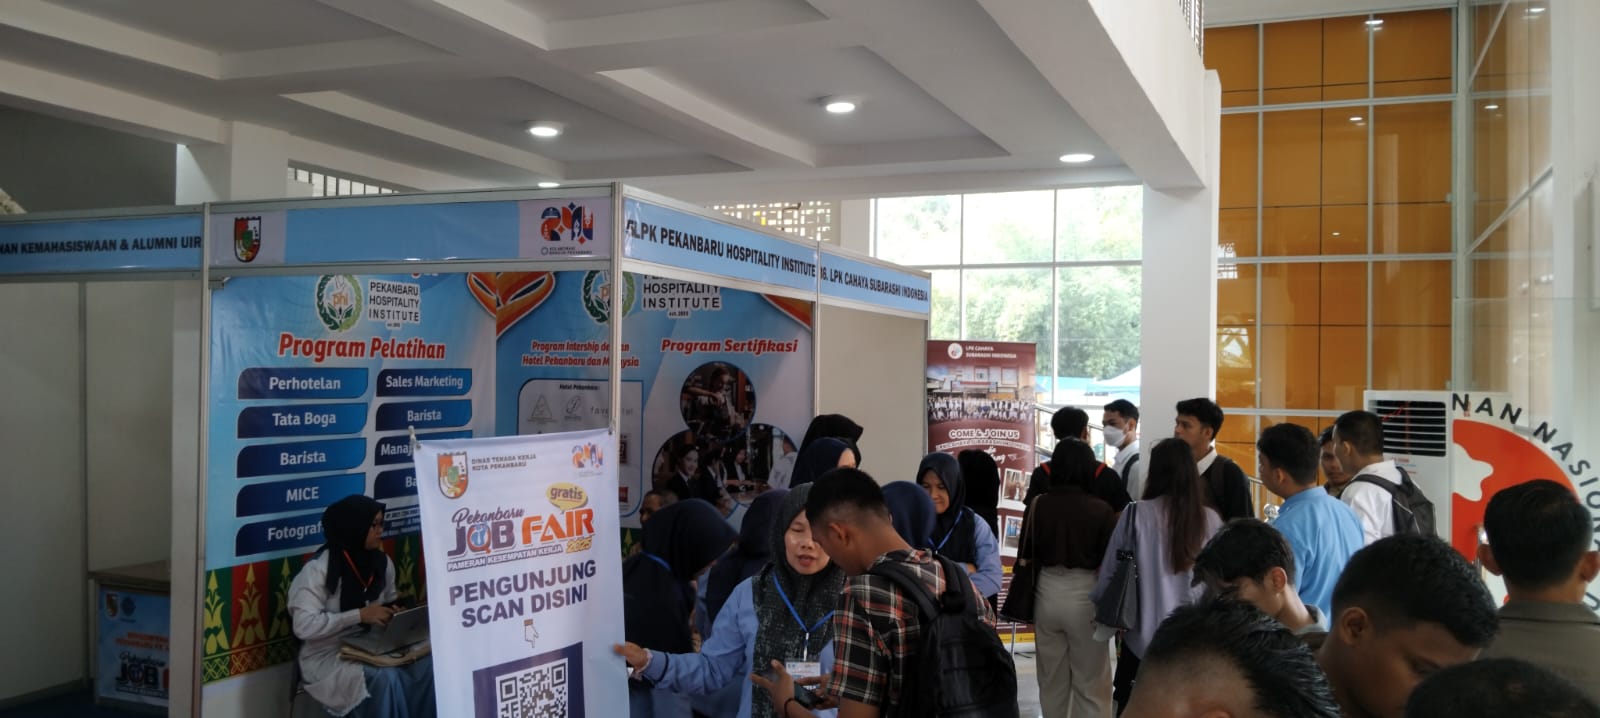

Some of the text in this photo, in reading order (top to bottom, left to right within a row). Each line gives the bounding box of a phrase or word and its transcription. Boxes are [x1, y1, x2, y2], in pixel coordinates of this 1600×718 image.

[20, 237, 117, 254] KEMAHASISWAAN
[120, 238, 129, 251] &
[132, 237, 178, 251] ALUMNI
[181, 236, 202, 250] UIR
[660, 228, 724, 257] PEKANBARU
[726, 244, 780, 270] HOSPITALITY
[781, 256, 816, 278] INSTITUTE
[370, 281, 419, 296] PEKANBARU
[643, 282, 720, 294] HOSPITALITY
[830, 268, 843, 284] LPK
[844, 272, 869, 290] CAHAYA
[869, 278, 901, 297] SUBARASHI
[901, 285, 929, 302] INDONESIA
[369, 295, 419, 308] HOSPITALITY
[643, 297, 720, 309] INSTITUTE
[368, 309, 419, 322] INSTITUTE
[278, 333, 446, 363] Program Pelatihan
[532, 341, 630, 353] Program Intership dean
[660, 338, 799, 356] Program Sertifikasi
[522, 355, 640, 369] Hotel Pekanbaru dan Mysia
[269, 377, 341, 390] Perhotelan
[385, 375, 464, 390] Sales Marketing
[272, 412, 337, 428] Tata Boga
[407, 410, 442, 422] Barista
[950, 430, 974, 438] COME
[1007, 430, 1019, 438] US
[280, 452, 327, 466] Barista
[286, 486, 320, 502] MICE
[550, 485, 583, 500] gratis
[451, 506, 525, 528] Pekanbaru
[447, 508, 594, 556] JOB FAIR 2025
[447, 545, 563, 571] PAMERAN KESEMPATAN KERJA
[449, 559, 597, 606] PENGUNJUNG
[461, 583, 588, 628] SCAN DISINI
